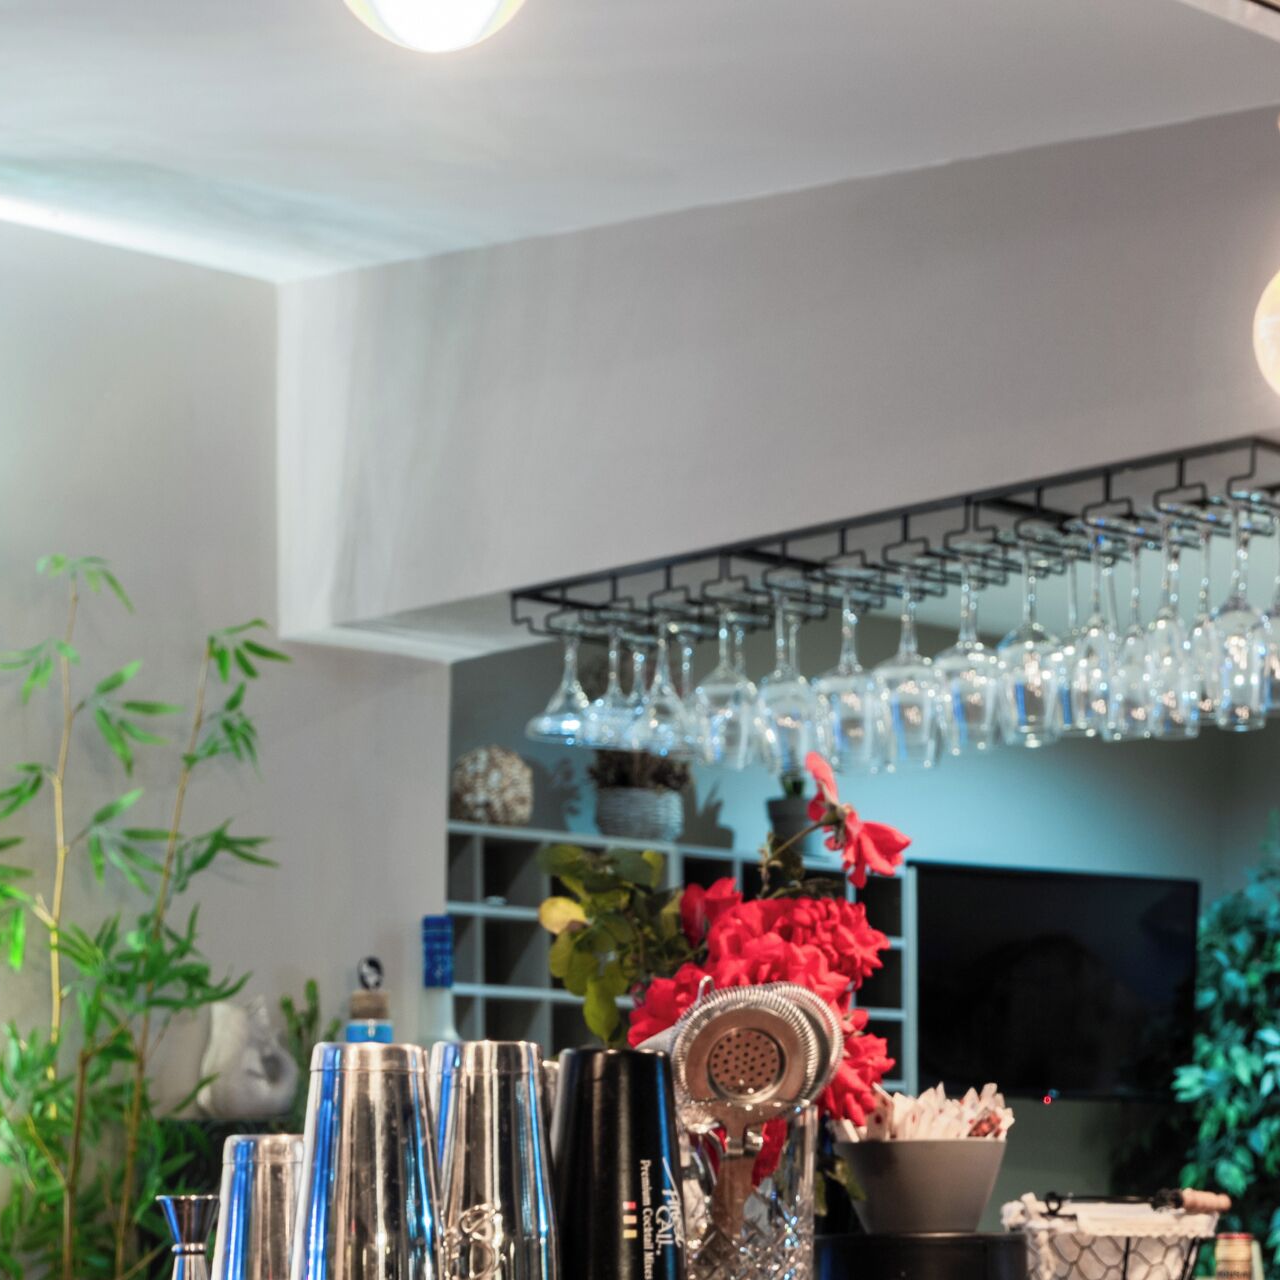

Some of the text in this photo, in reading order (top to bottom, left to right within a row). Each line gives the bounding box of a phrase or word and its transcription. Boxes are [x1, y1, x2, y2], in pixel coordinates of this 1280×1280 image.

[640, 1160, 654, 1280] Premium Cocktail Mixes
